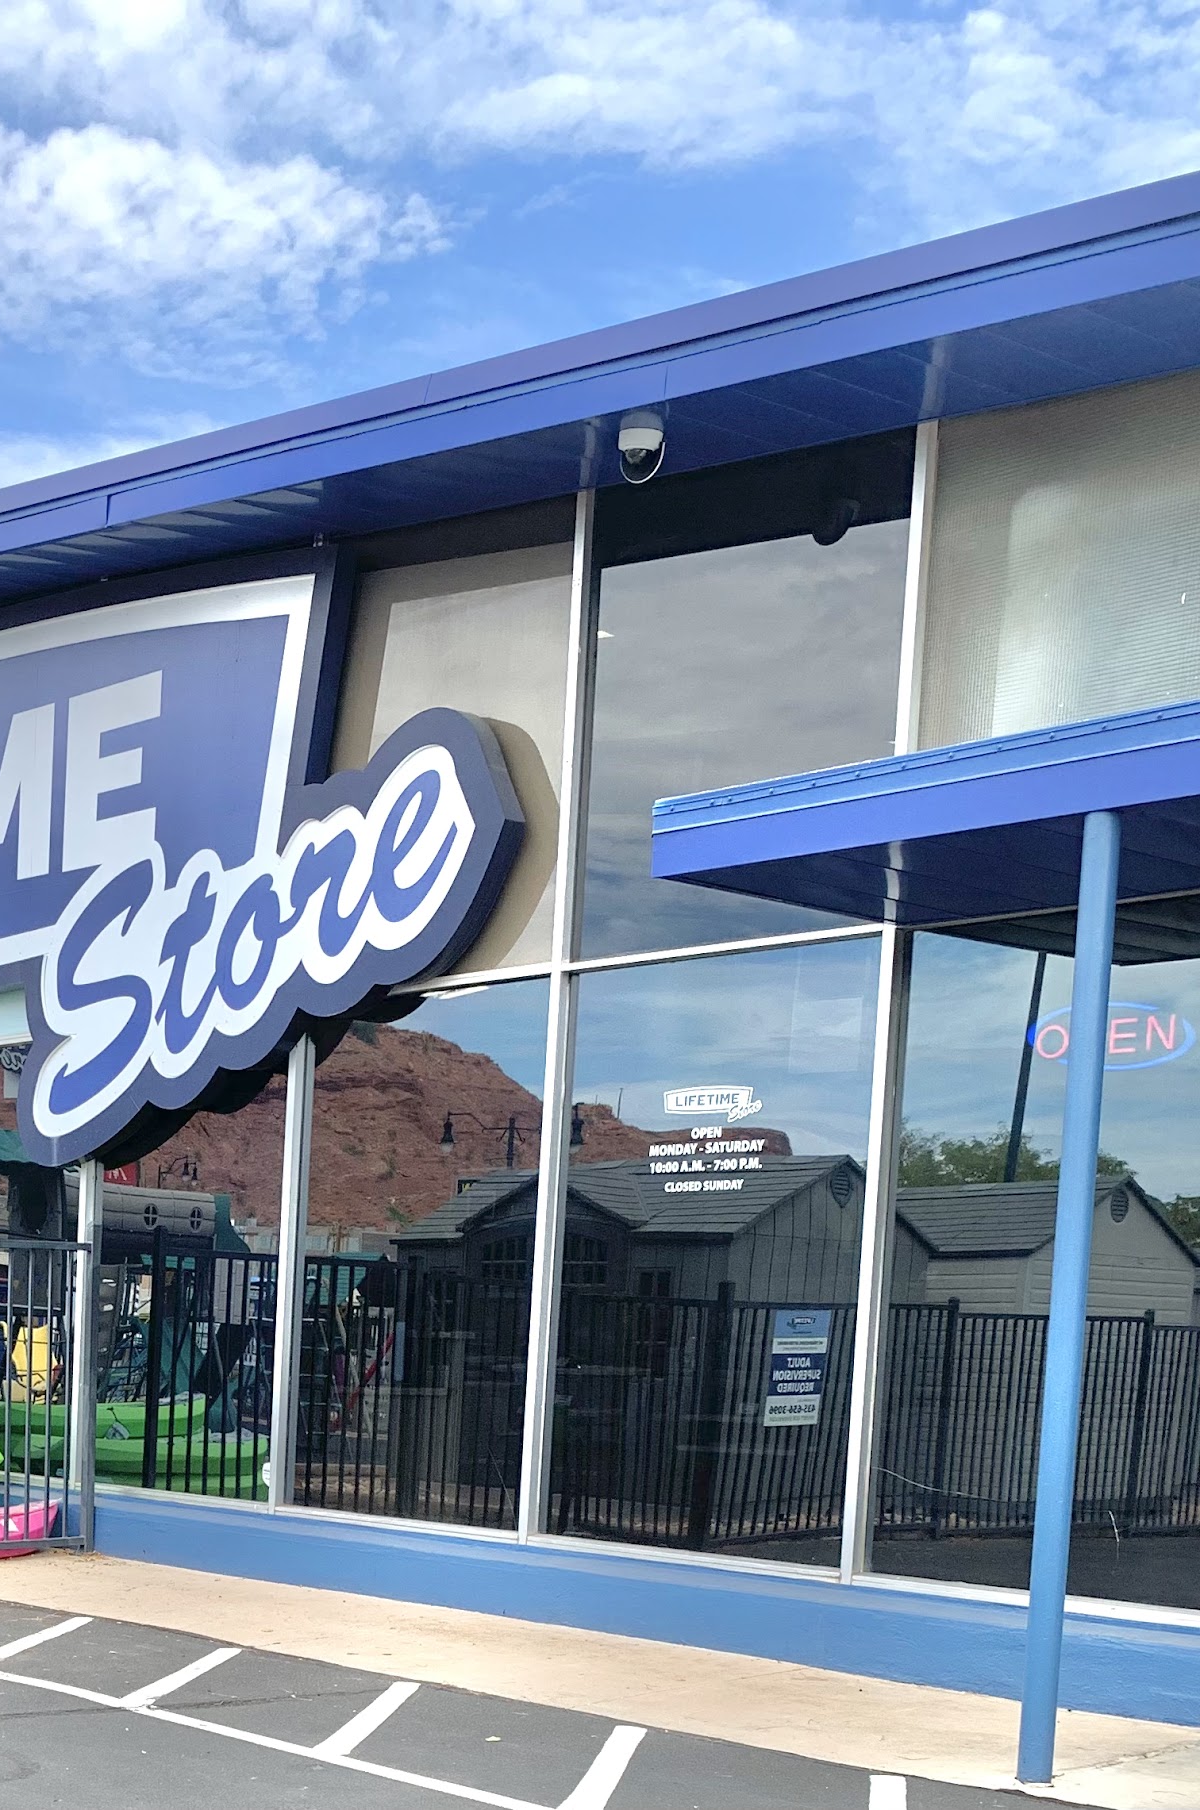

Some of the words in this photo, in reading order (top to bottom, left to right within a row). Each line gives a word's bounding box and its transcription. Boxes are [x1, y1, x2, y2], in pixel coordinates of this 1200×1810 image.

[47, 767, 459, 1114] Store
[1036, 1013, 1176, 1059] OEN
[675, 1093, 740, 1107] LIFETIME
[728, 1100, 762, 1122] Store
[691, 1126, 722, 1139] OPEN
[649, 1143, 698, 1157] MONDAY
[705, 1139, 765, 1154] SATURDAY
[650, 1161, 679, 1174] 10:00
[680, 1160, 705, 1173] A.M.
[713, 1158, 737, 1171] 7:00
[739, 1157, 762, 1169] P.M.
[664, 1181, 702, 1192] CLOSED
[702, 1179, 744, 1191] SUNDAY
